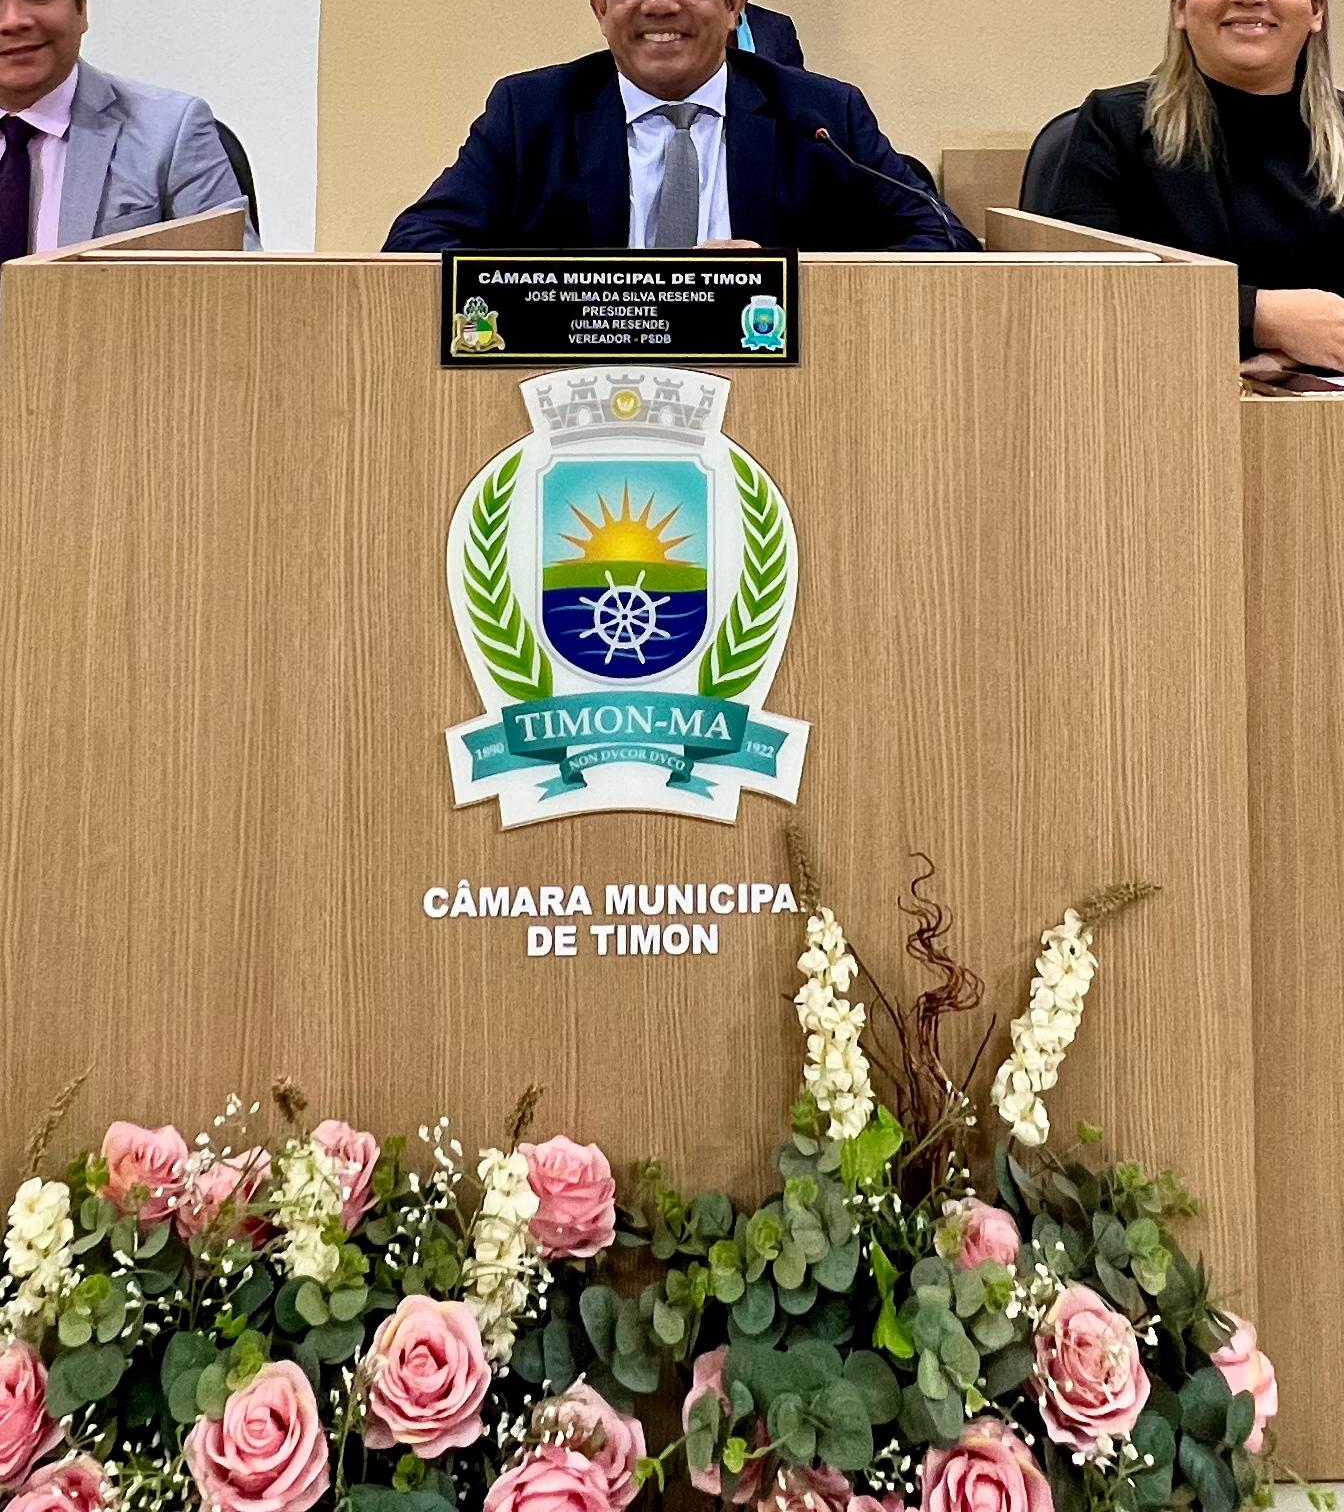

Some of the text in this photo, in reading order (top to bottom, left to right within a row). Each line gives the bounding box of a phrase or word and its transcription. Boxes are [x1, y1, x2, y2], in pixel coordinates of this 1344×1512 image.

[478, 270, 762, 286] CÂMARA MUNICIPAL DE TIMON
[524, 289, 557, 303] JOSÉ
[602, 291, 620, 302] DA
[622, 291, 656, 302] SILVA
[658, 291, 716, 302] RESENDE
[582, 305, 658, 317] PRESIDENTE
[612, 319, 670, 332] RESENDE)
[568, 333, 632, 344] VEREADOR
[640, 333, 672, 344] PSDB
[515, 704, 733, 743] TIMON-MA
[423, 879, 807, 918] CÂMARA MUNICIPA
[527, 923, 719, 957] DE TIMON
